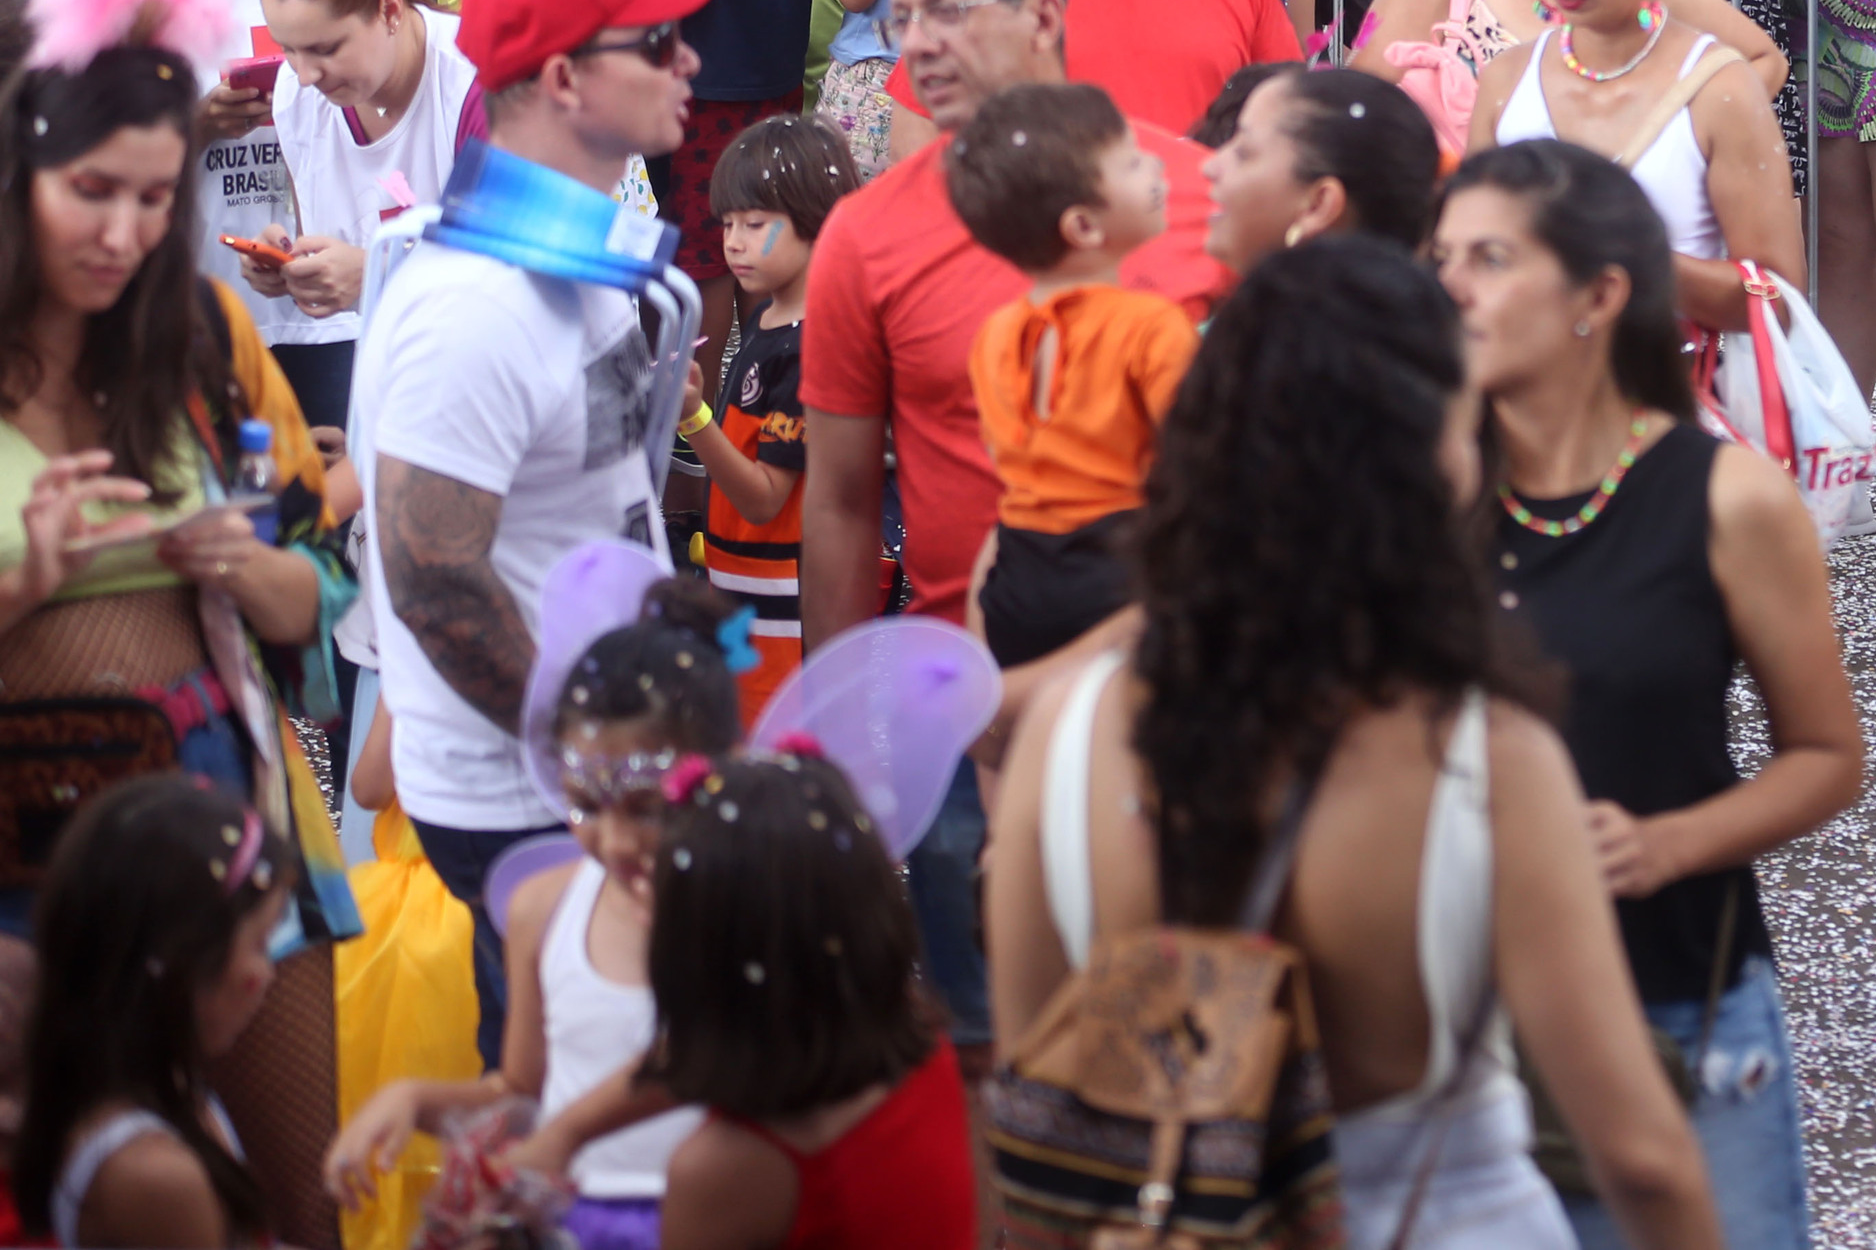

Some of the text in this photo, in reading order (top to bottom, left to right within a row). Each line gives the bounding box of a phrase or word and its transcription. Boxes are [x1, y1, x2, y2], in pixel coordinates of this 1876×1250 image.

[206, 142, 282, 172] CRUZ VER
[226, 194, 286, 208] MATO GROS
